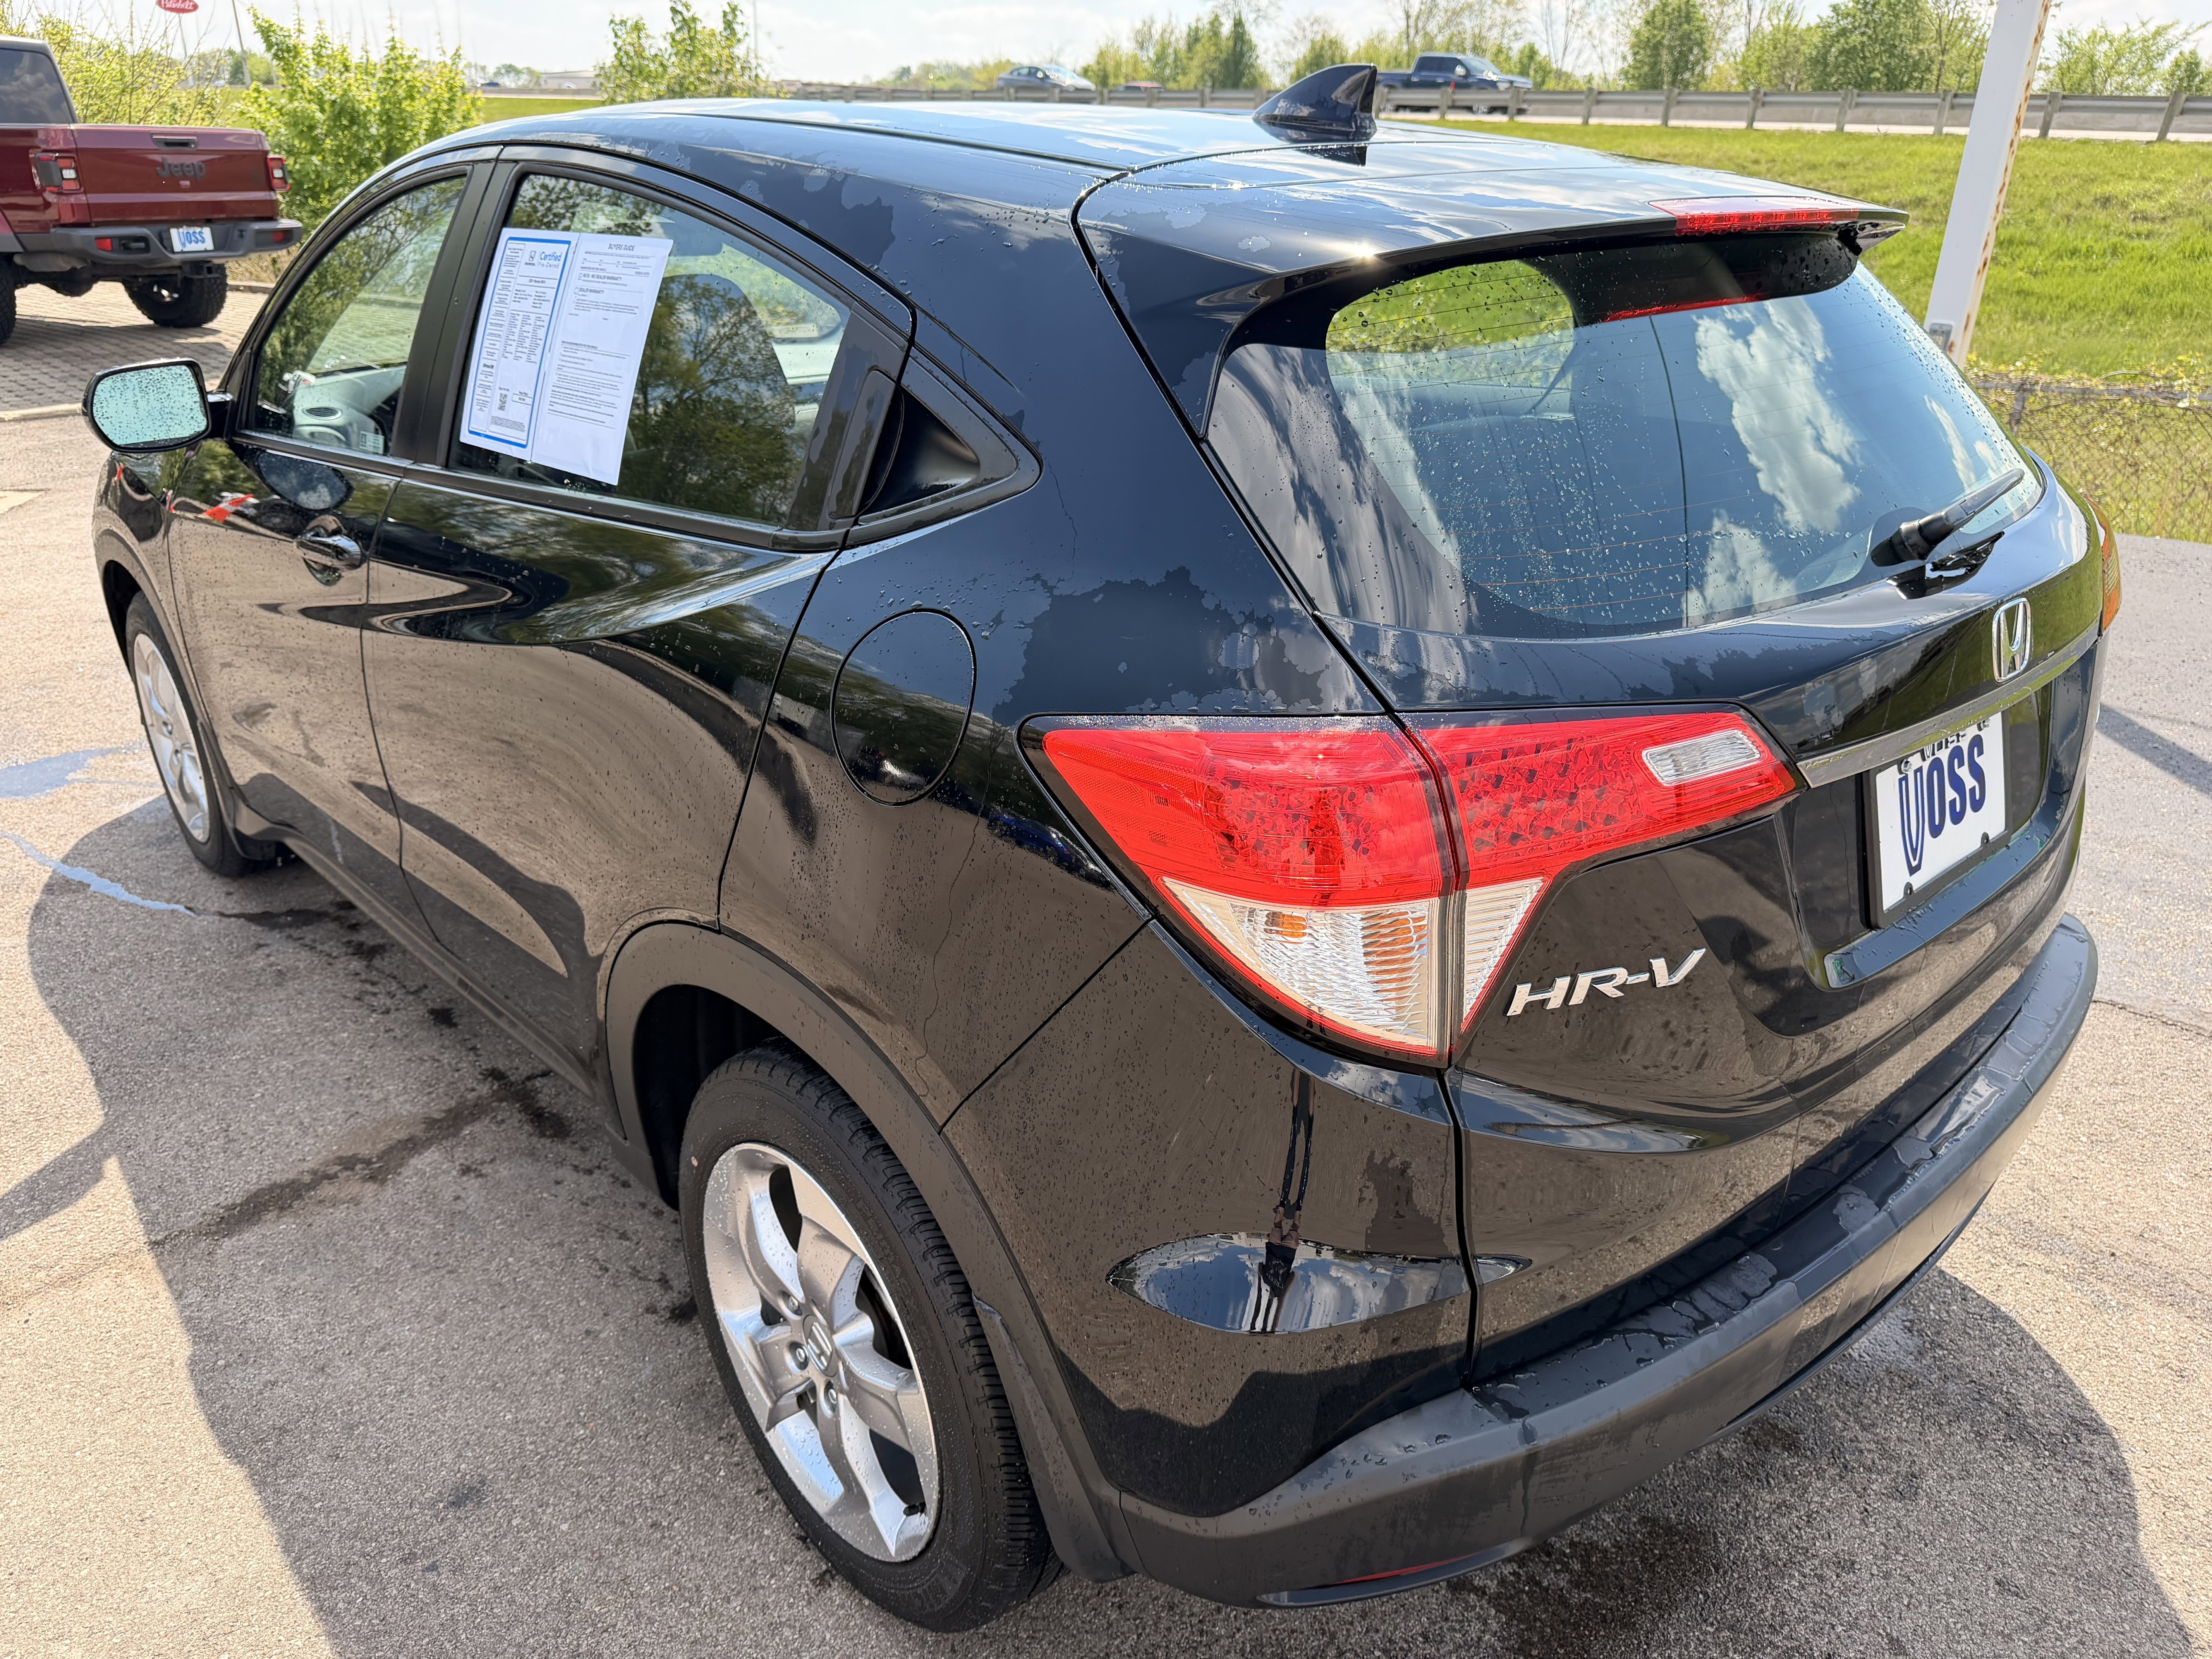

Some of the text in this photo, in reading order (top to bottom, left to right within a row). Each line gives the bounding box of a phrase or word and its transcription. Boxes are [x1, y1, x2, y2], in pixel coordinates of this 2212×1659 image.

[156, 157, 207, 181] Jeep
[178, 231, 205, 248] VOSS
[540, 251, 562, 261] Certified
[1898, 734, 1986, 877] VOSS
[1503, 948, 1706, 1016] HR-V
